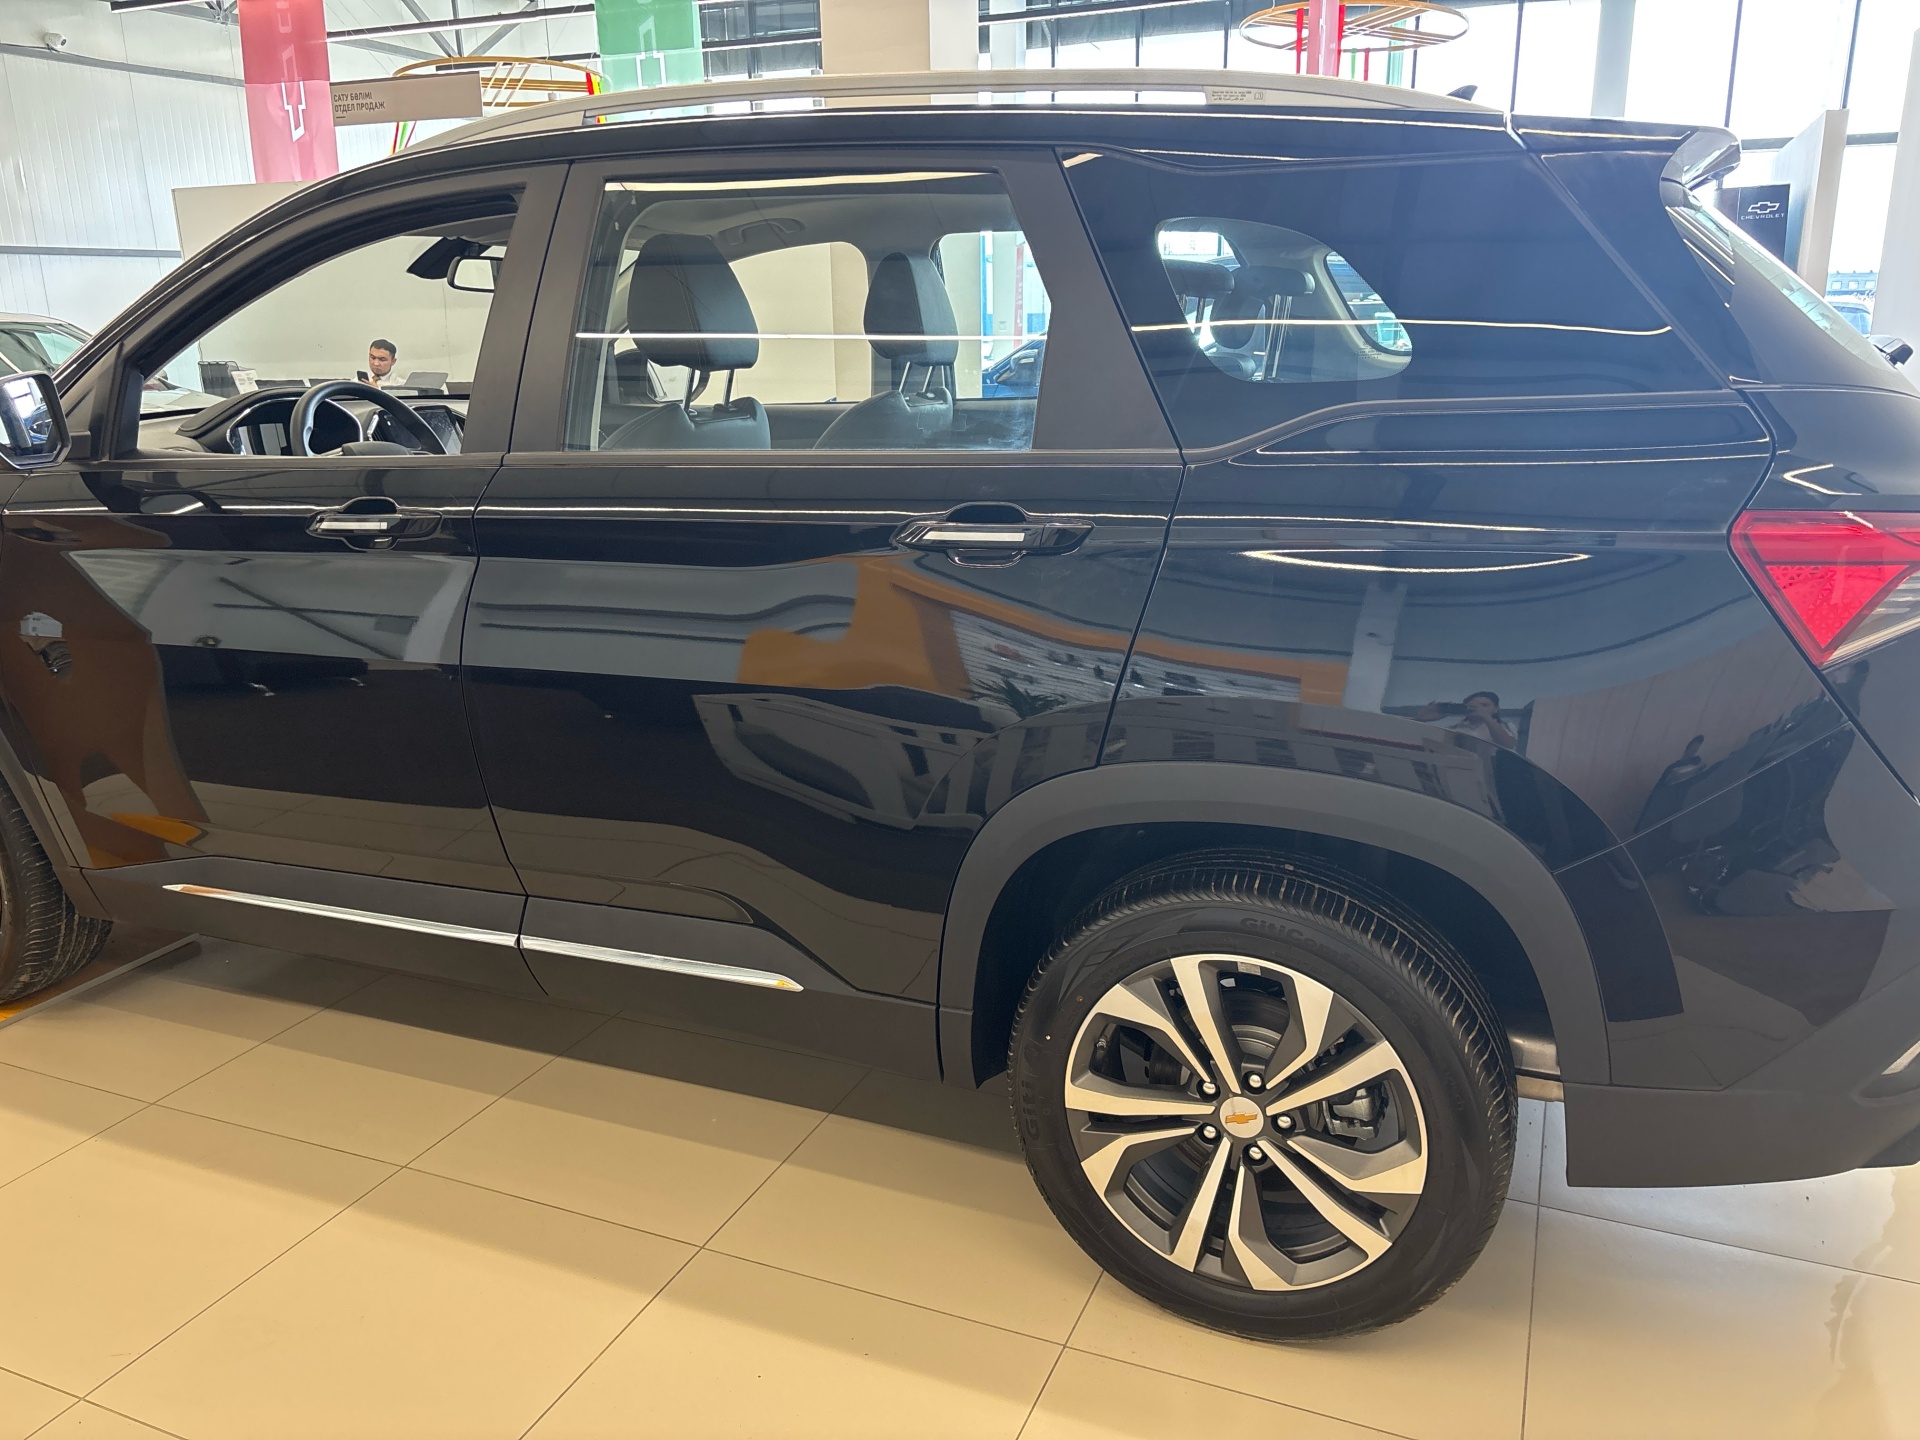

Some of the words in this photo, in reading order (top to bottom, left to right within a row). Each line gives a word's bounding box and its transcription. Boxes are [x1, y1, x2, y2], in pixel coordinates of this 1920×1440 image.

[333, 93, 348, 102] САТУ
[334, 103, 355, 114] ОТДЕЛ
[356, 101, 386, 112] ПРОДАЖ
